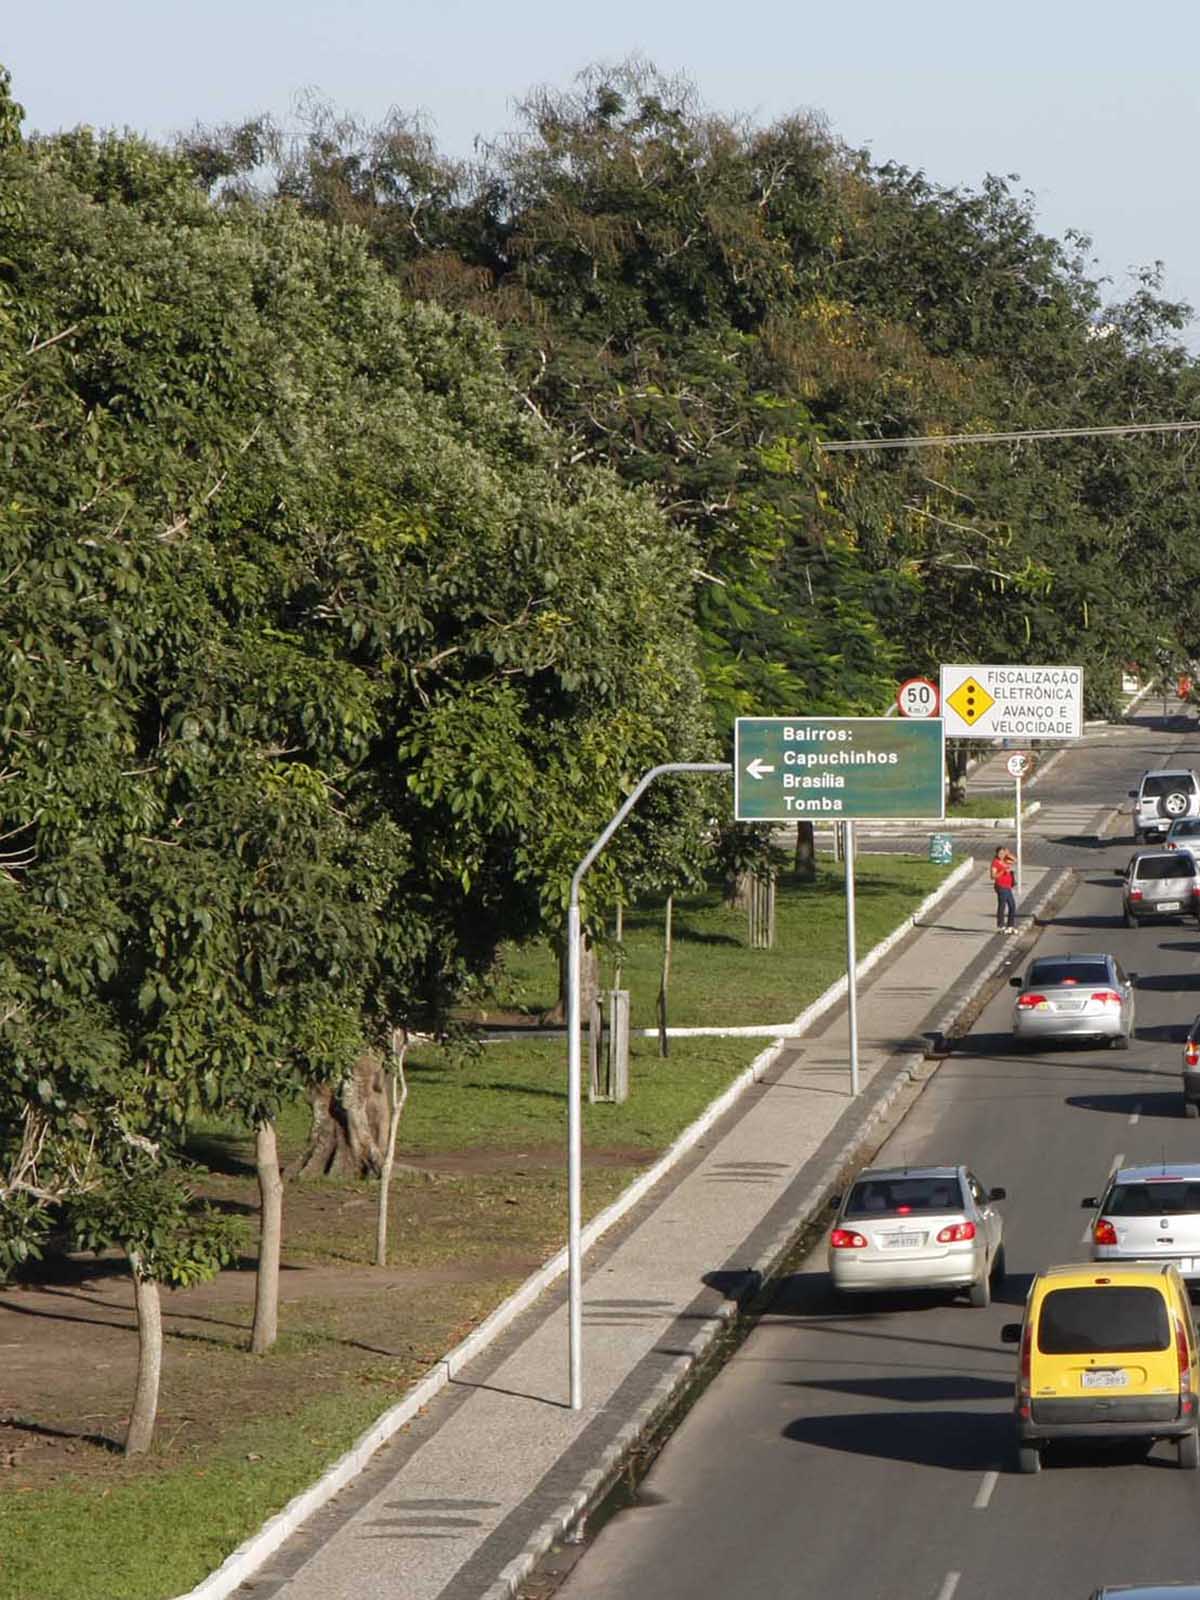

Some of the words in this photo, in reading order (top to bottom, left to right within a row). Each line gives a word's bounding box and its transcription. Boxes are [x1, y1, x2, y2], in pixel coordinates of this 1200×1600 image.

[987, 669, 1079, 685] FISCALIZAÇÃO
[907, 686, 930, 703] 50
[993, 685, 1074, 700] ELETRÔNICA
[1002, 705, 1055, 720] AVANÇO
[1059, 706, 1067, 718] E
[783, 727, 853, 741] Bairros:
[991, 720, 1073, 735] VELOCIDADE
[783, 750, 898, 766] Capuchinhos
[783, 774, 845, 788] Brasília
[783, 796, 843, 811] Tomba
